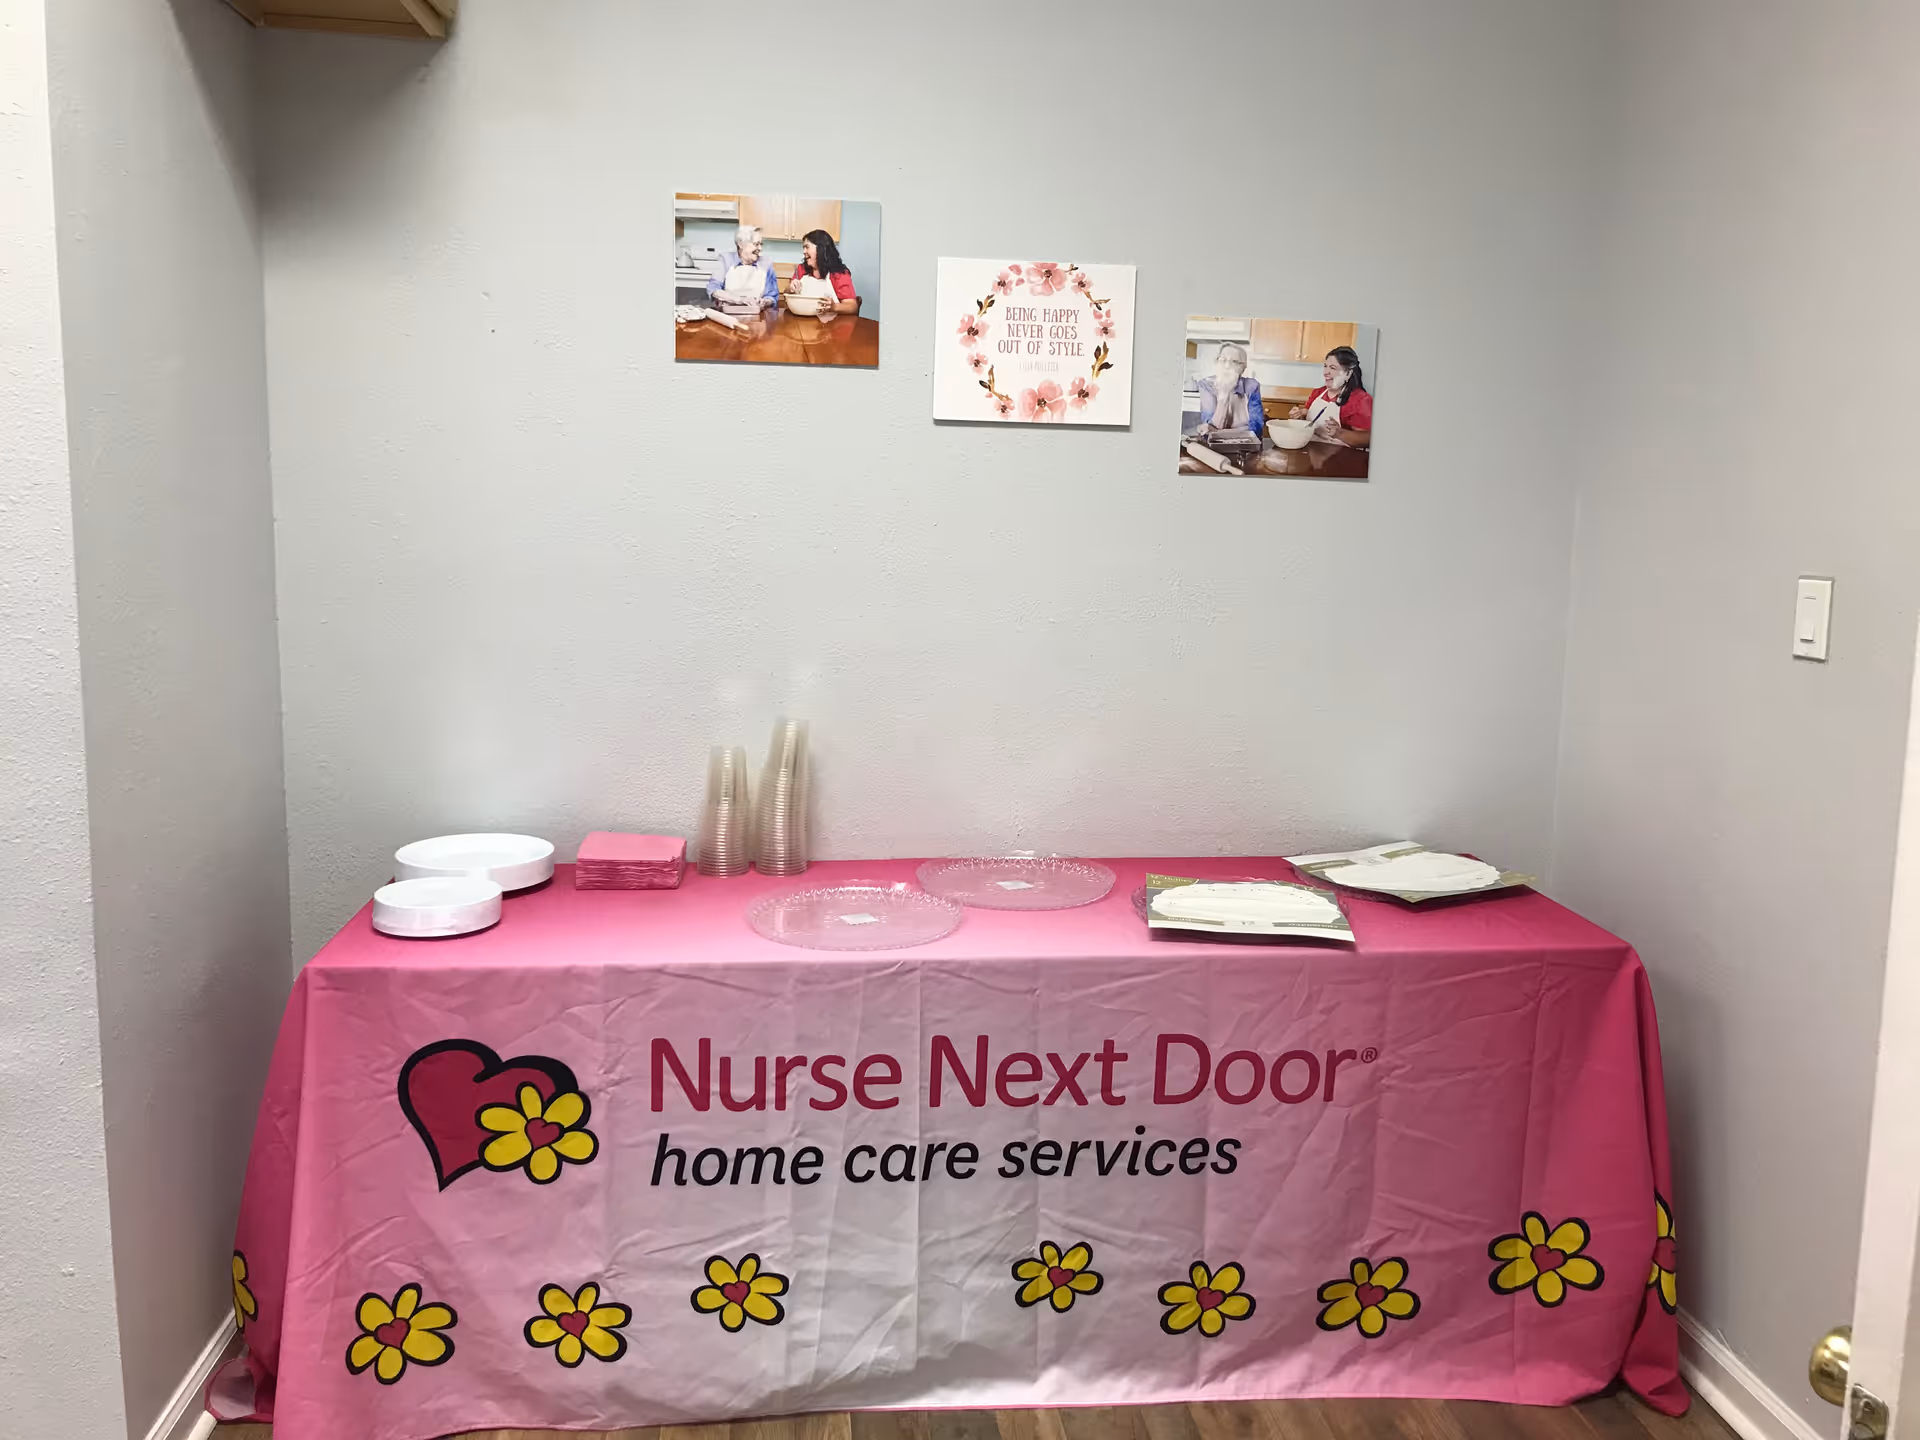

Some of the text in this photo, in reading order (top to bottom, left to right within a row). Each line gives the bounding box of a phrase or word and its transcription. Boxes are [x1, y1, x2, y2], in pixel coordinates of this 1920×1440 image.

[1005, 306, 1079, 323] BEING HAPPY
[1007, 323, 1078, 340] NEVER GOES
[998, 339, 1085, 357] OUT OF STYLE.
[650, 1037, 903, 1112] Nurse
[929, 1034, 1129, 1108] Next
[650, 1124, 1242, 1187] home care services
